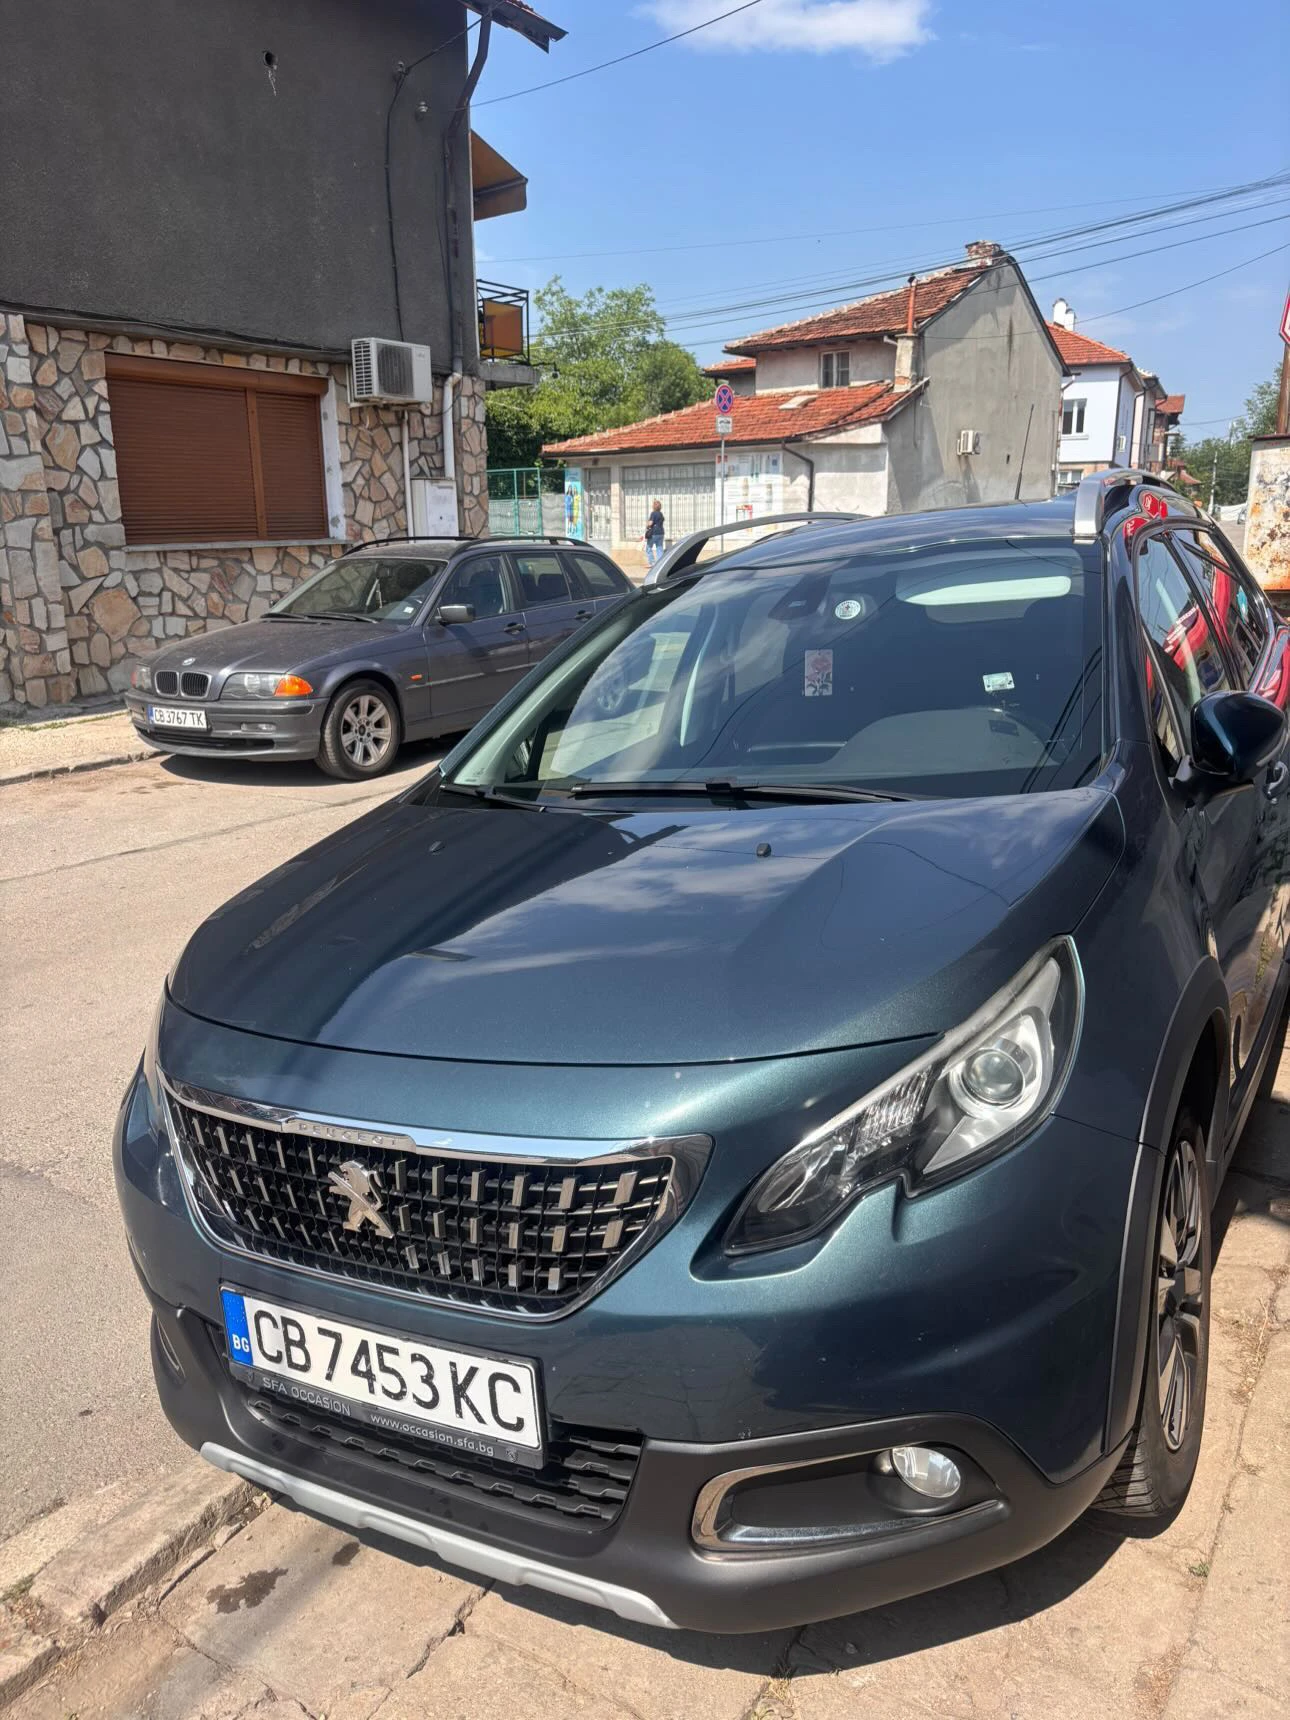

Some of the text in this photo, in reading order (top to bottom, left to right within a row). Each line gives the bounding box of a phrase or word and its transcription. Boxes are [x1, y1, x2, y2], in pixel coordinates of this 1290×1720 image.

[232, 1333, 250, 1353] BG
[262, 1377, 351, 1416] SFA OCCASION
[370, 1414, 494, 1456] www.occasion.sfa.bg
